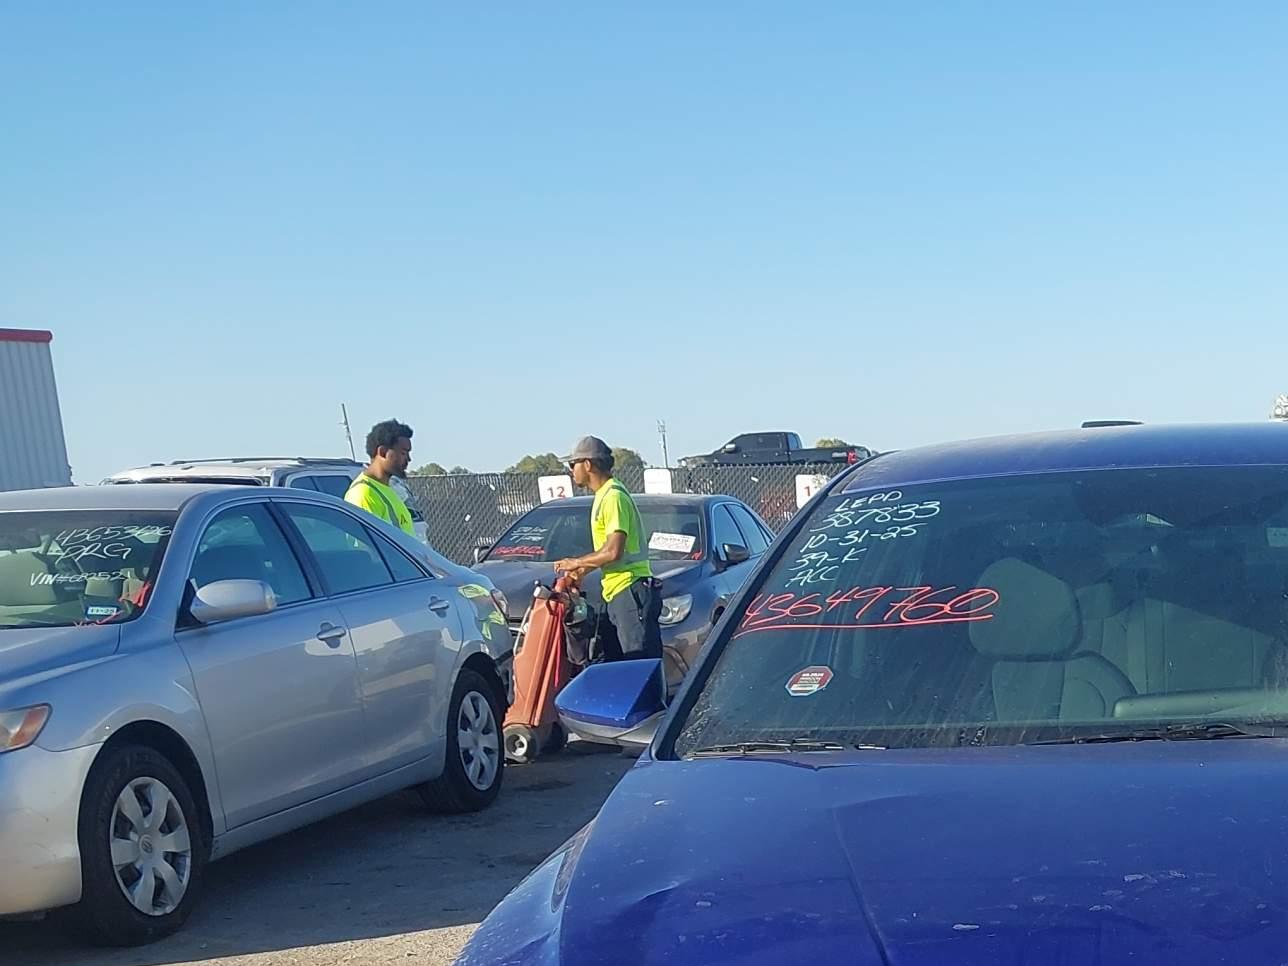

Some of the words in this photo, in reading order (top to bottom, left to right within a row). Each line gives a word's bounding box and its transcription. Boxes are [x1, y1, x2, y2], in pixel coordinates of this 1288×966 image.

[546, 486, 566, 498] 12
[809, 500, 941, 532] 387833
[800, 522, 928, 553] 10-31-25
[784, 565, 840, 588] ACC
[741, 586, 1000, 628] 43649760
